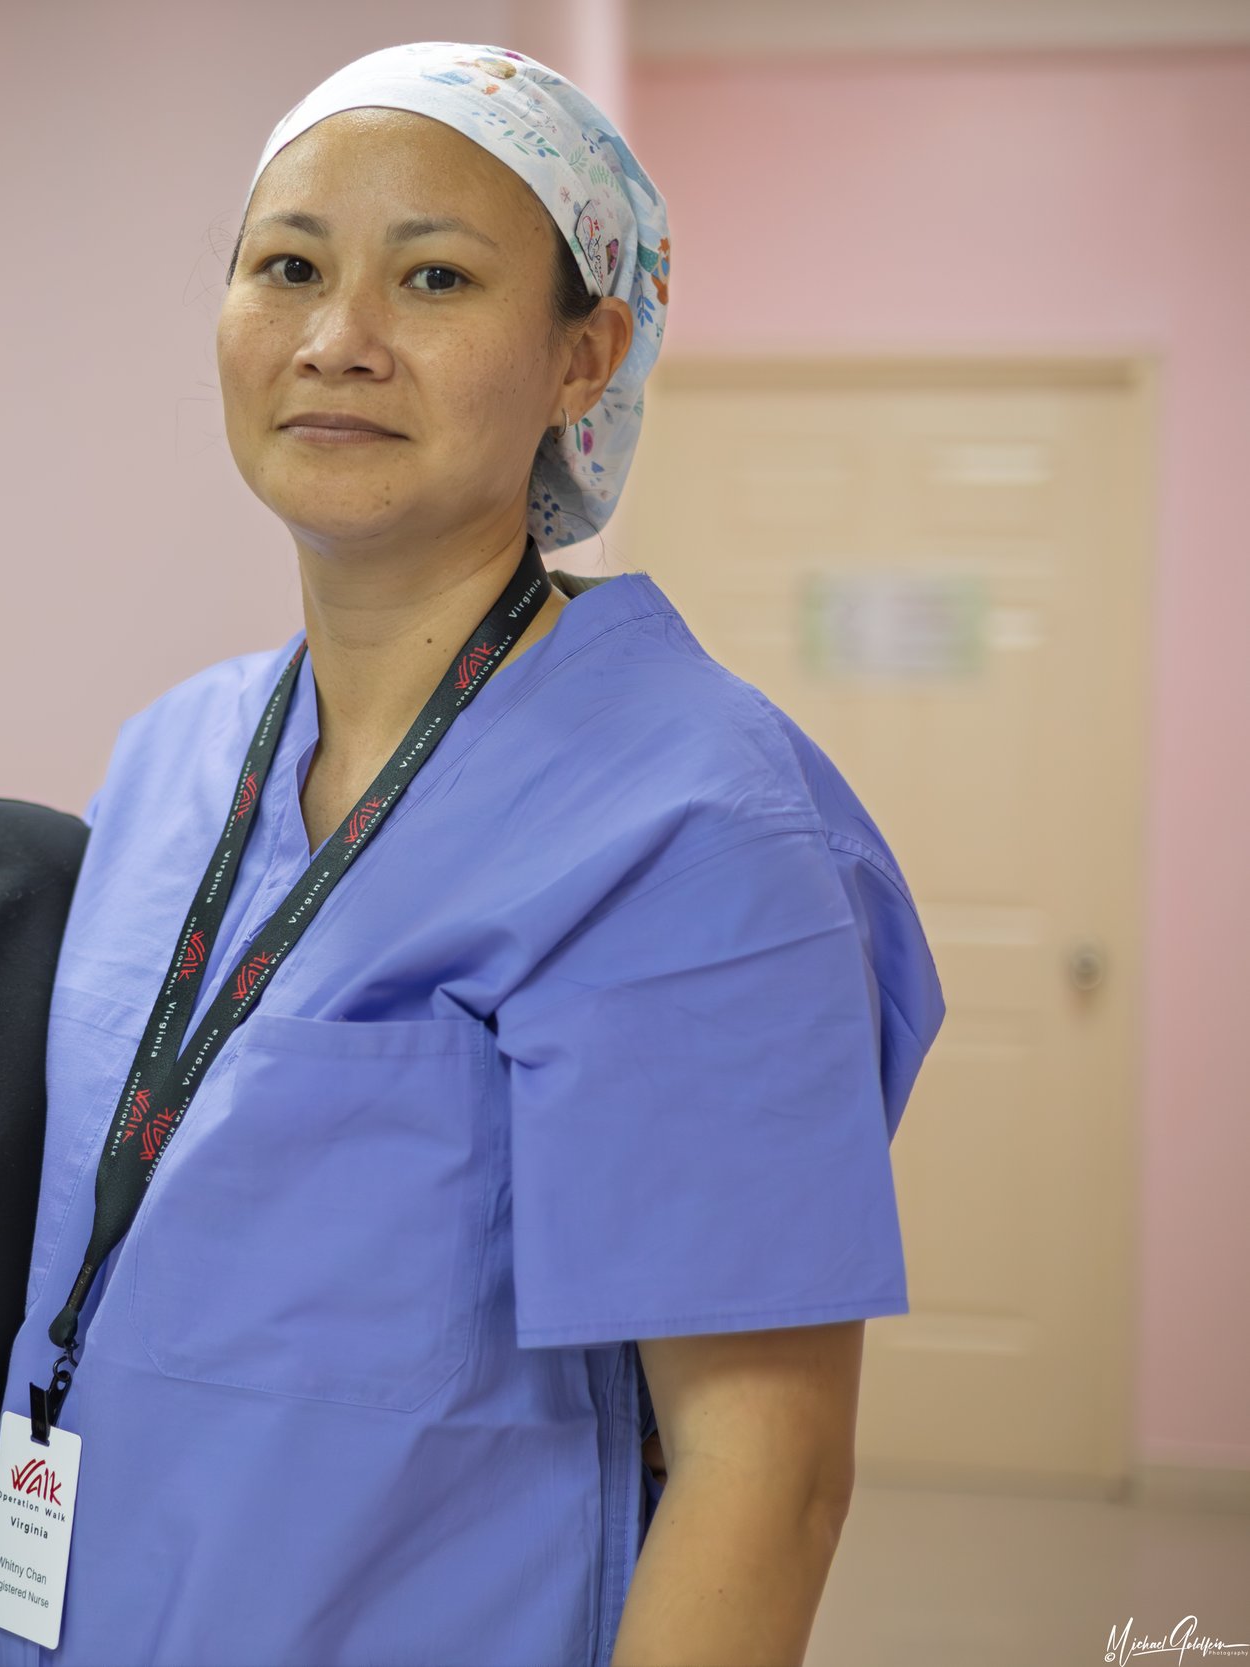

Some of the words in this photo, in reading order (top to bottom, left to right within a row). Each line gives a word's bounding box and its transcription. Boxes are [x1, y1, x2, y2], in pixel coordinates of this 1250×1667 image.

[509, 579, 542, 618] Virginia
[456, 660, 493, 706] OPERATION
[494, 635, 512, 657] WALK
[399, 716, 441, 768] Virginia
[344, 812, 381, 861] OPERATION
[382, 785, 400, 807] WALK
[206, 850, 231, 903] Virginia
[288, 871, 329, 924] Virginia
[176, 917, 197, 967] OPERATION
[165, 972, 178, 994] WALK
[233, 969, 270, 1018] OPERATION
[271, 941, 289, 965] WALK
[151, 1001, 177, 1057] Virginia
[182, 1029, 218, 1086] Virginia
[120, 1072, 141, 1126] OPERATION
[111, 1131, 123, 1156] WALK
[146, 1127, 175, 1182] OPERATION
[175, 1097, 190, 1123] WALK
[10, 1516, 49, 1540] Virginia
[45, 1507, 66, 1522] Walk
[26, 1568, 47, 1585] Chan
[28, 1591, 49, 1608] Nurse
